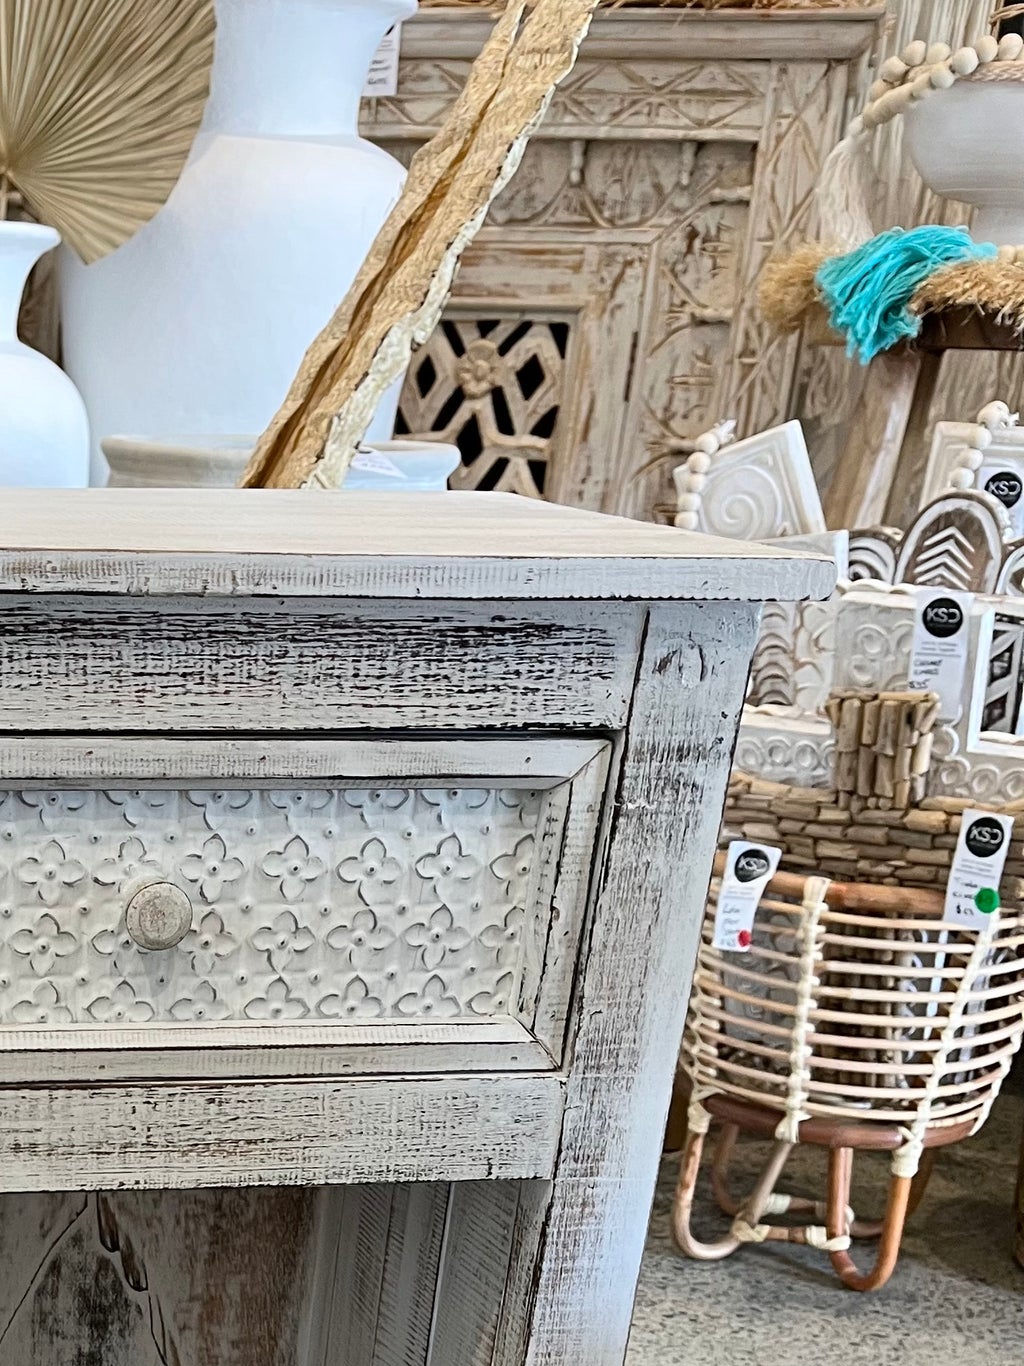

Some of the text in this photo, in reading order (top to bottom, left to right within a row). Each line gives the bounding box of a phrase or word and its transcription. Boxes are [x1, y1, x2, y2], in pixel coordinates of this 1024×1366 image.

[988, 480, 1021, 496] KSD
[926, 607, 961, 623] KSD
[969, 825, 1003, 844] KSD
[738, 855, 770, 873] KSD
